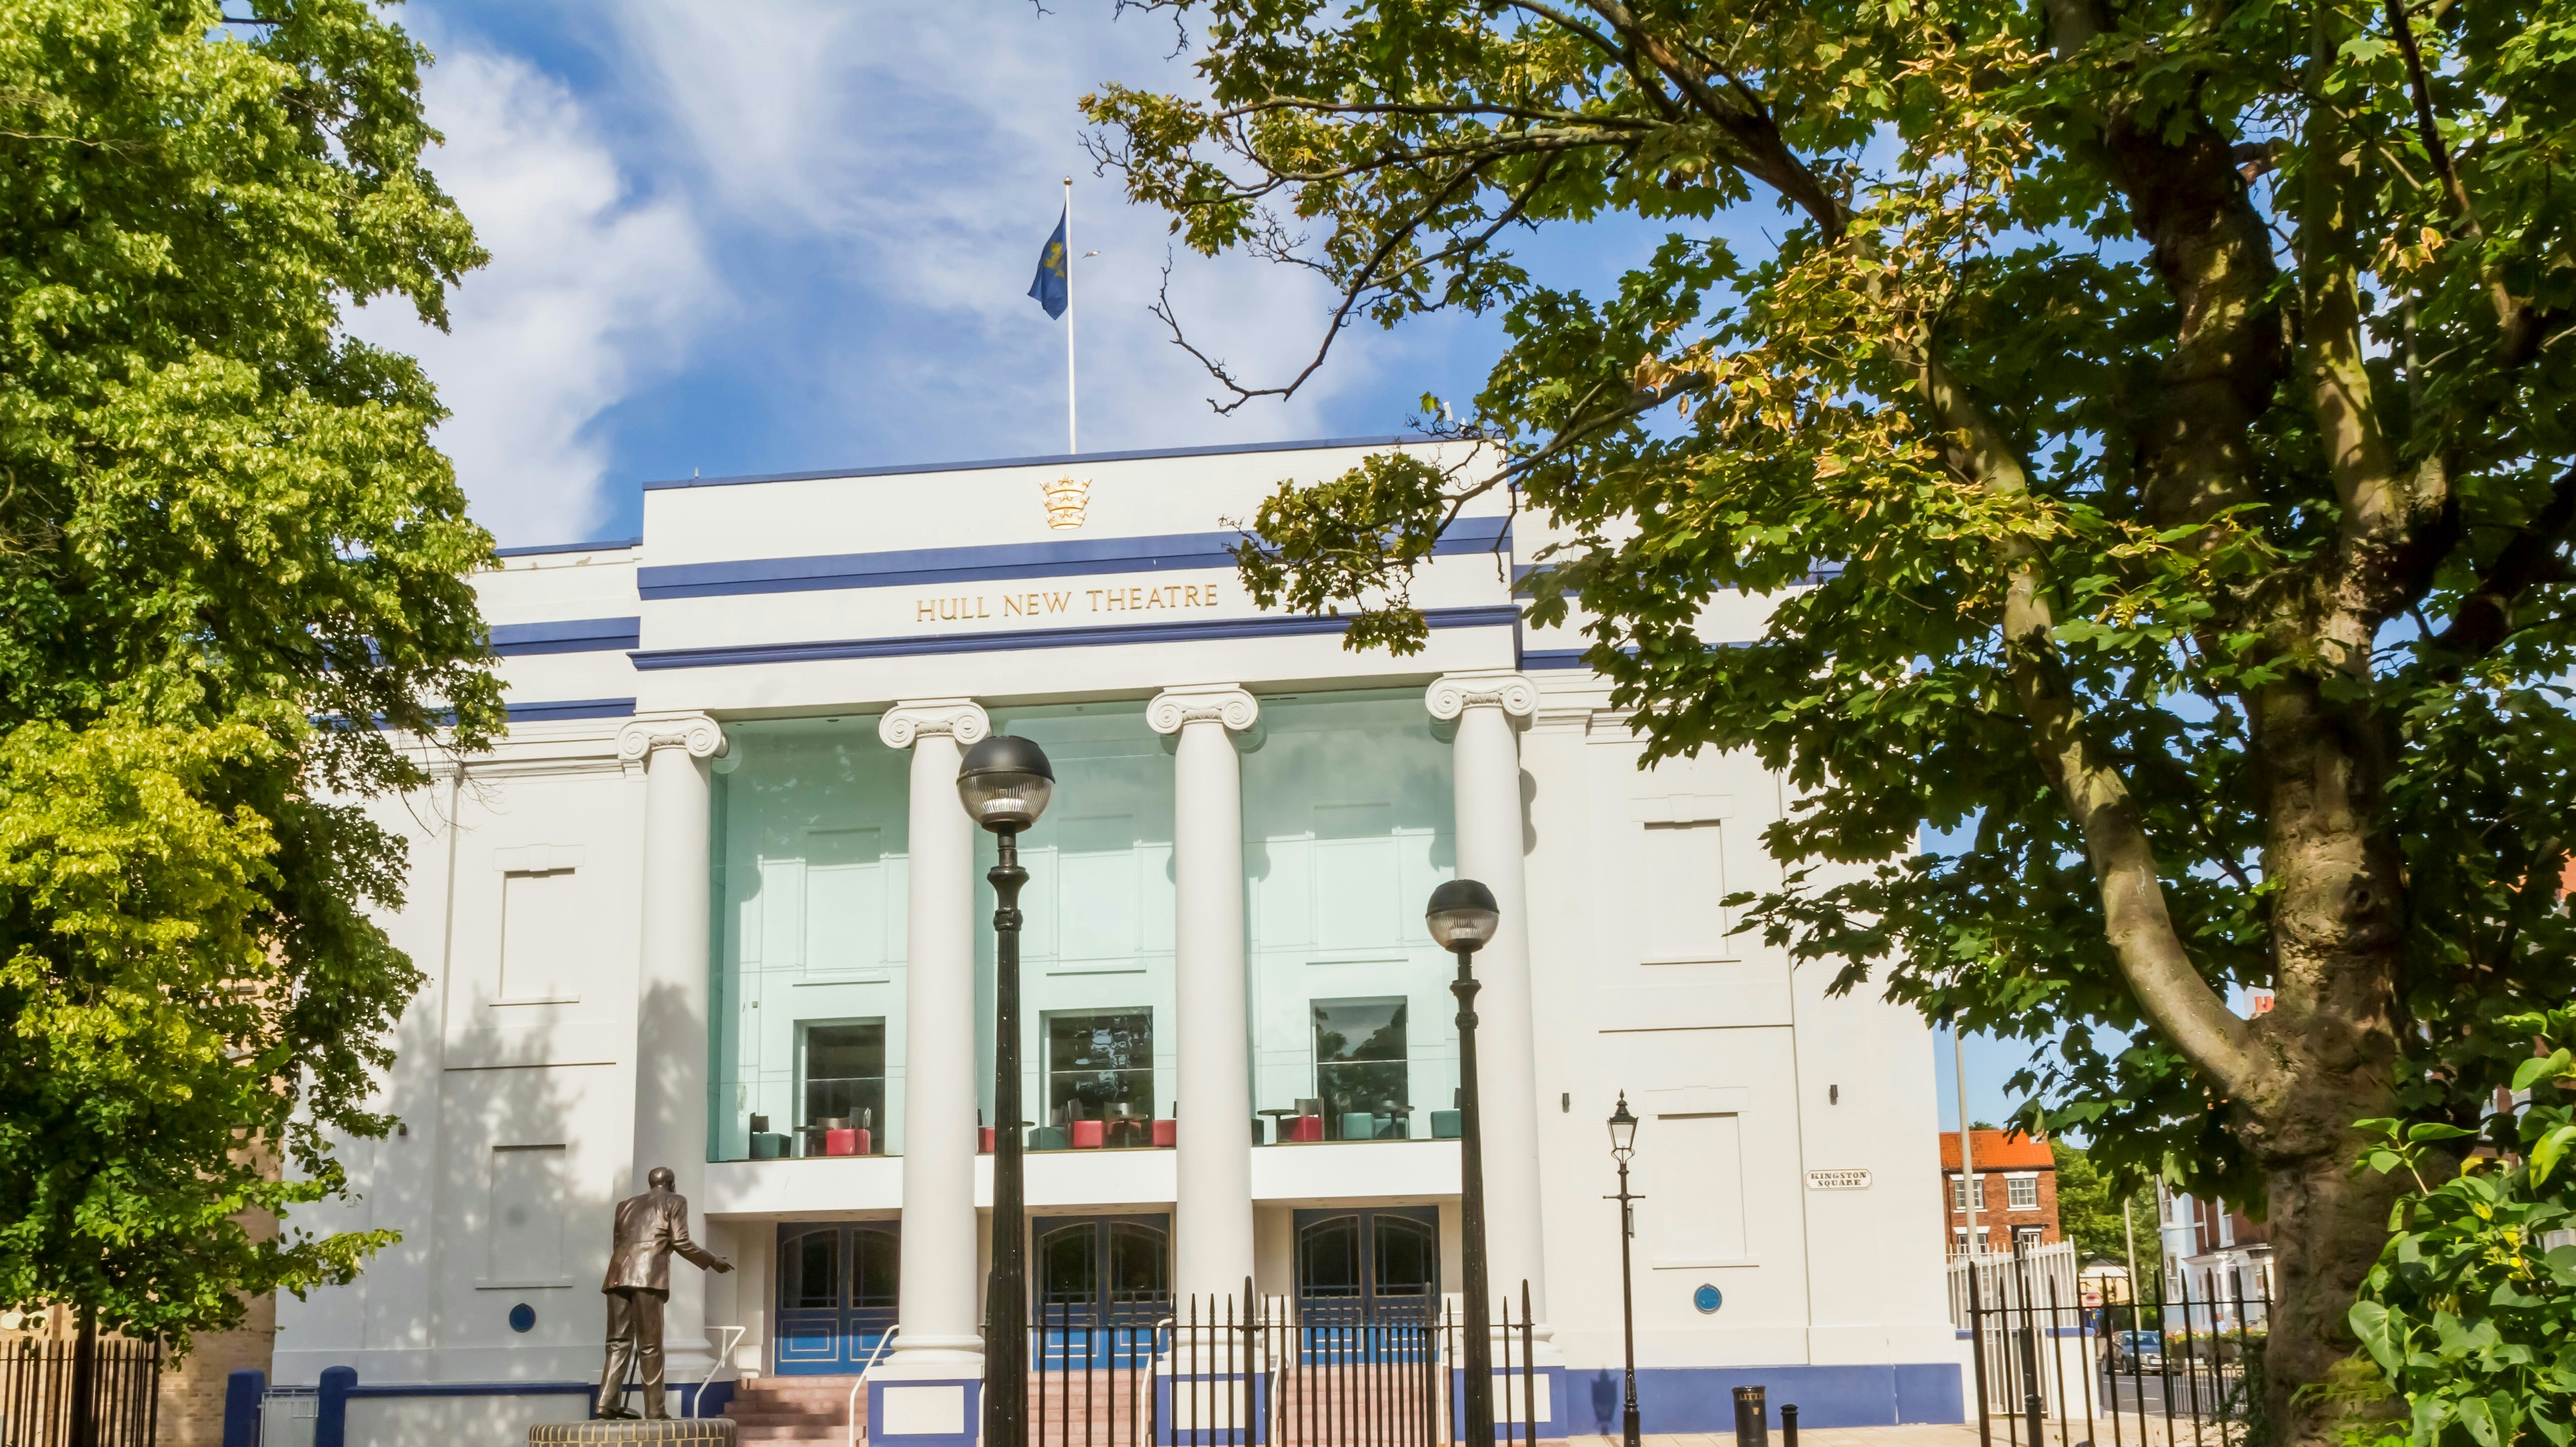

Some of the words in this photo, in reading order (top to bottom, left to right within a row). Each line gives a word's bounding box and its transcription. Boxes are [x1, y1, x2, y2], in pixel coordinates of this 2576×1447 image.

[916, 597, 990, 622] HULL
[1004, 591, 1072, 617] NEW
[1086, 584, 1218, 612] THEATRE
[1817, 1179, 1861, 1187] SQUARE
